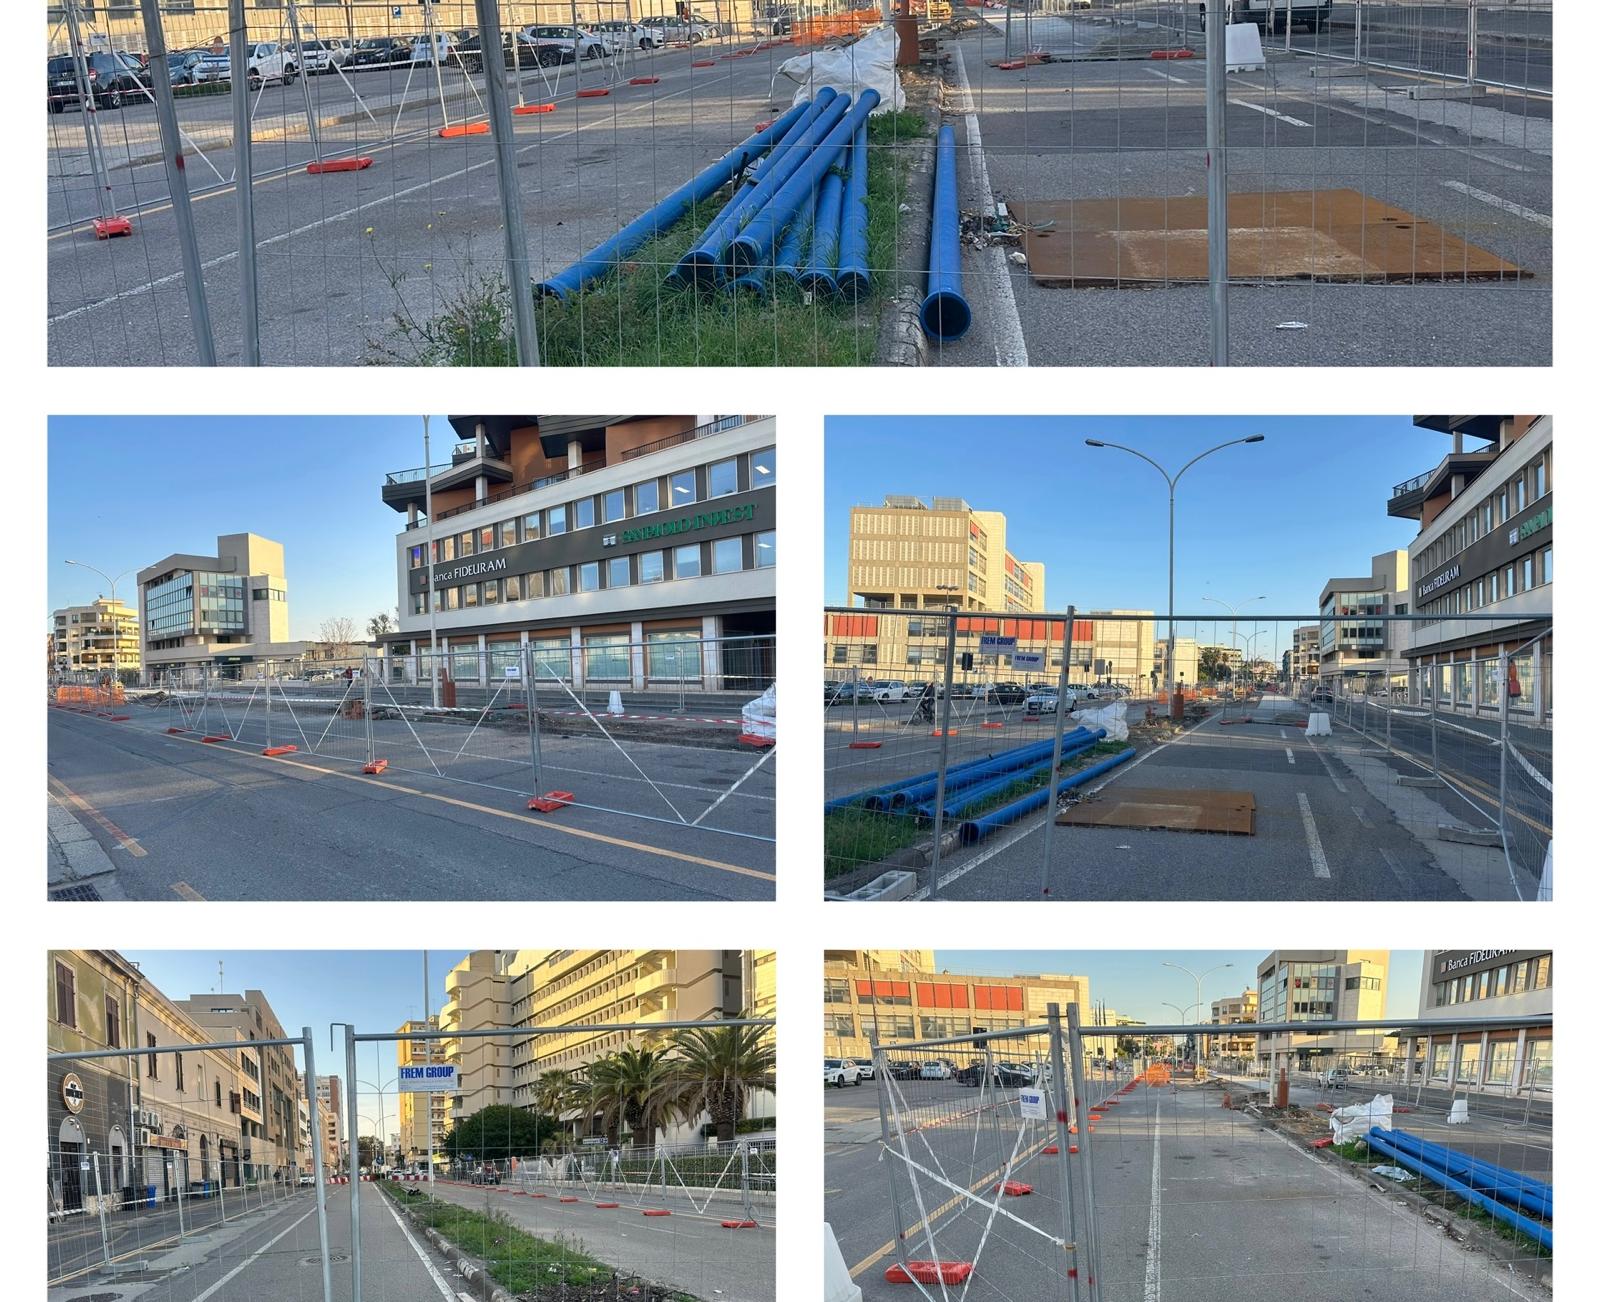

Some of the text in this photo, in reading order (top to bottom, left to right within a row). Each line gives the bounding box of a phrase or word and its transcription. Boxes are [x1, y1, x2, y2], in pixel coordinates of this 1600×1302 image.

[433, 558, 506, 582] anca FIDEURAM
[1448, 957, 1468, 971] Banca
[400, 1066, 454, 1079] FREM GROUP
